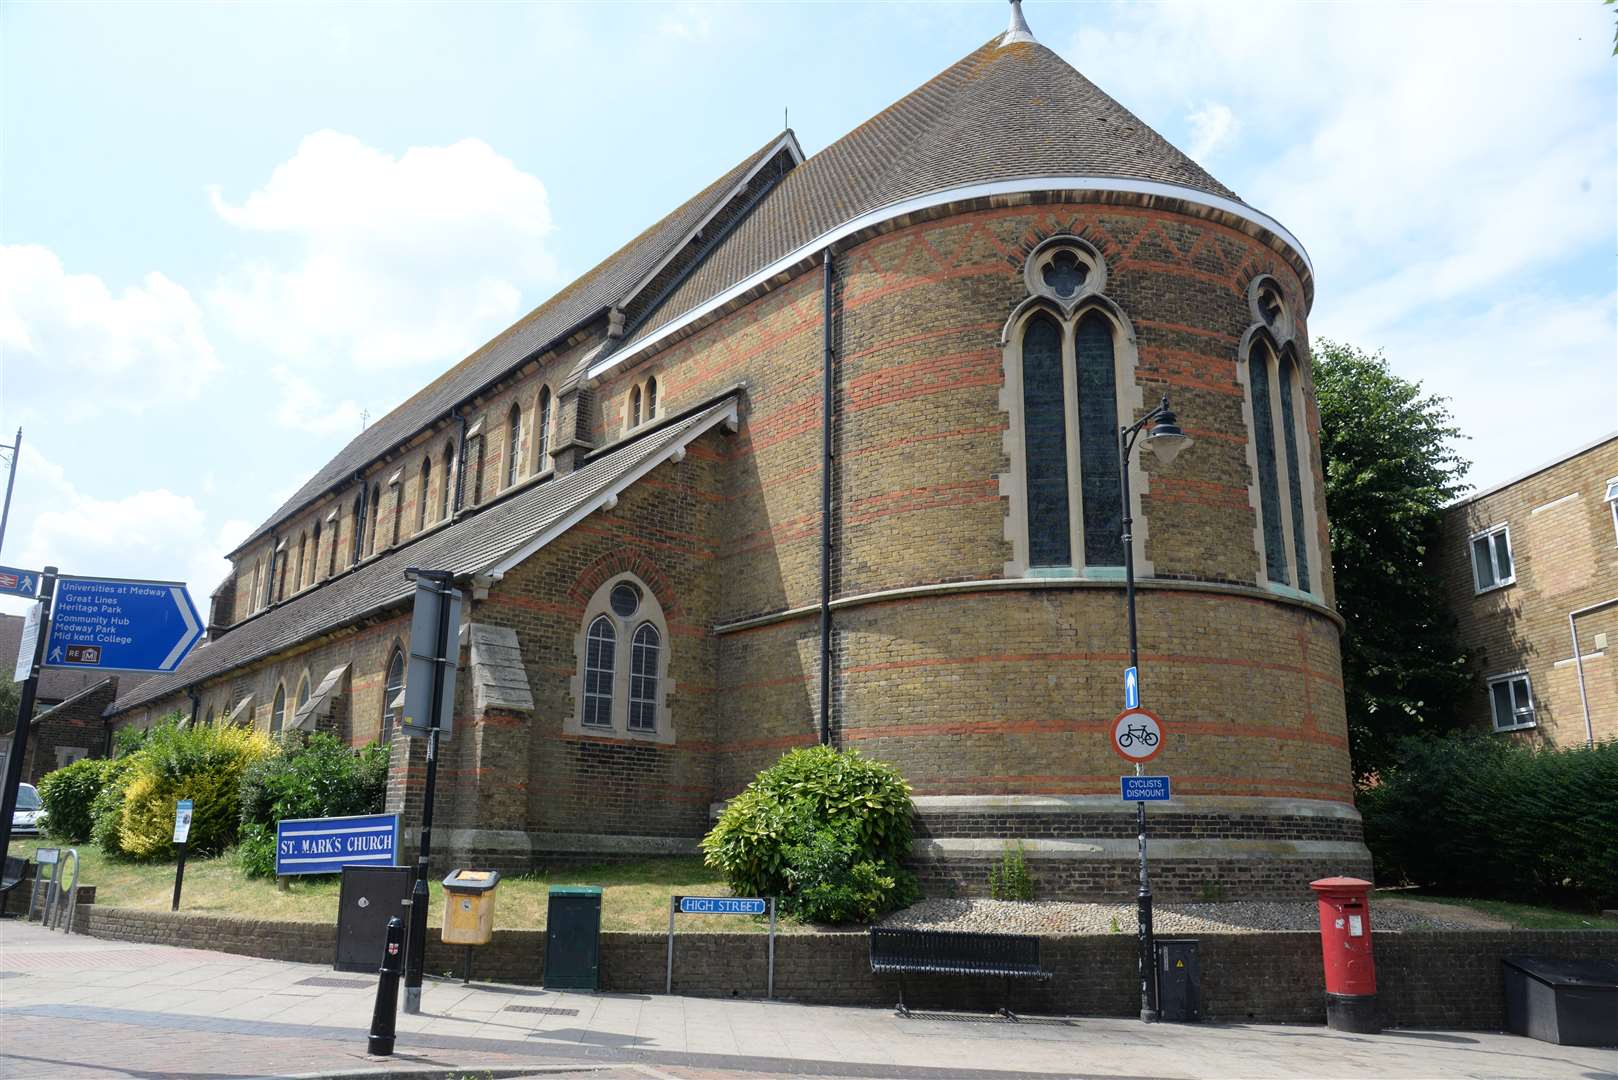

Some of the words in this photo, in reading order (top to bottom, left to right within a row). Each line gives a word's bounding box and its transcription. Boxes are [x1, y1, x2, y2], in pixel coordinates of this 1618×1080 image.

[63, 583, 114, 594] Universities
[130, 586, 166, 598] Medway
[66, 594, 92, 604] Great
[95, 596, 118, 604] Lines
[58, 603, 98, 613] Heritage
[56, 614, 108, 625] Community
[112, 616, 130, 625] Hub
[56, 623, 92, 633] Medway
[96, 626, 116, 634] Park
[54, 632, 71, 640] Mid
[74, 633, 94, 642] kent
[97, 634, 132, 645] College
[68, 650, 80, 658] RE
[1129, 780, 1162, 788] CYCLISTS
[1127, 788, 1165, 798] DISMOUNT
[281, 840, 298, 854] ST.
[302, 836, 342, 854] MARK'S
[347, 835, 392, 852] CHURCH
[686, 900, 713, 910] HIGH
[718, 900, 760, 912] STREET
